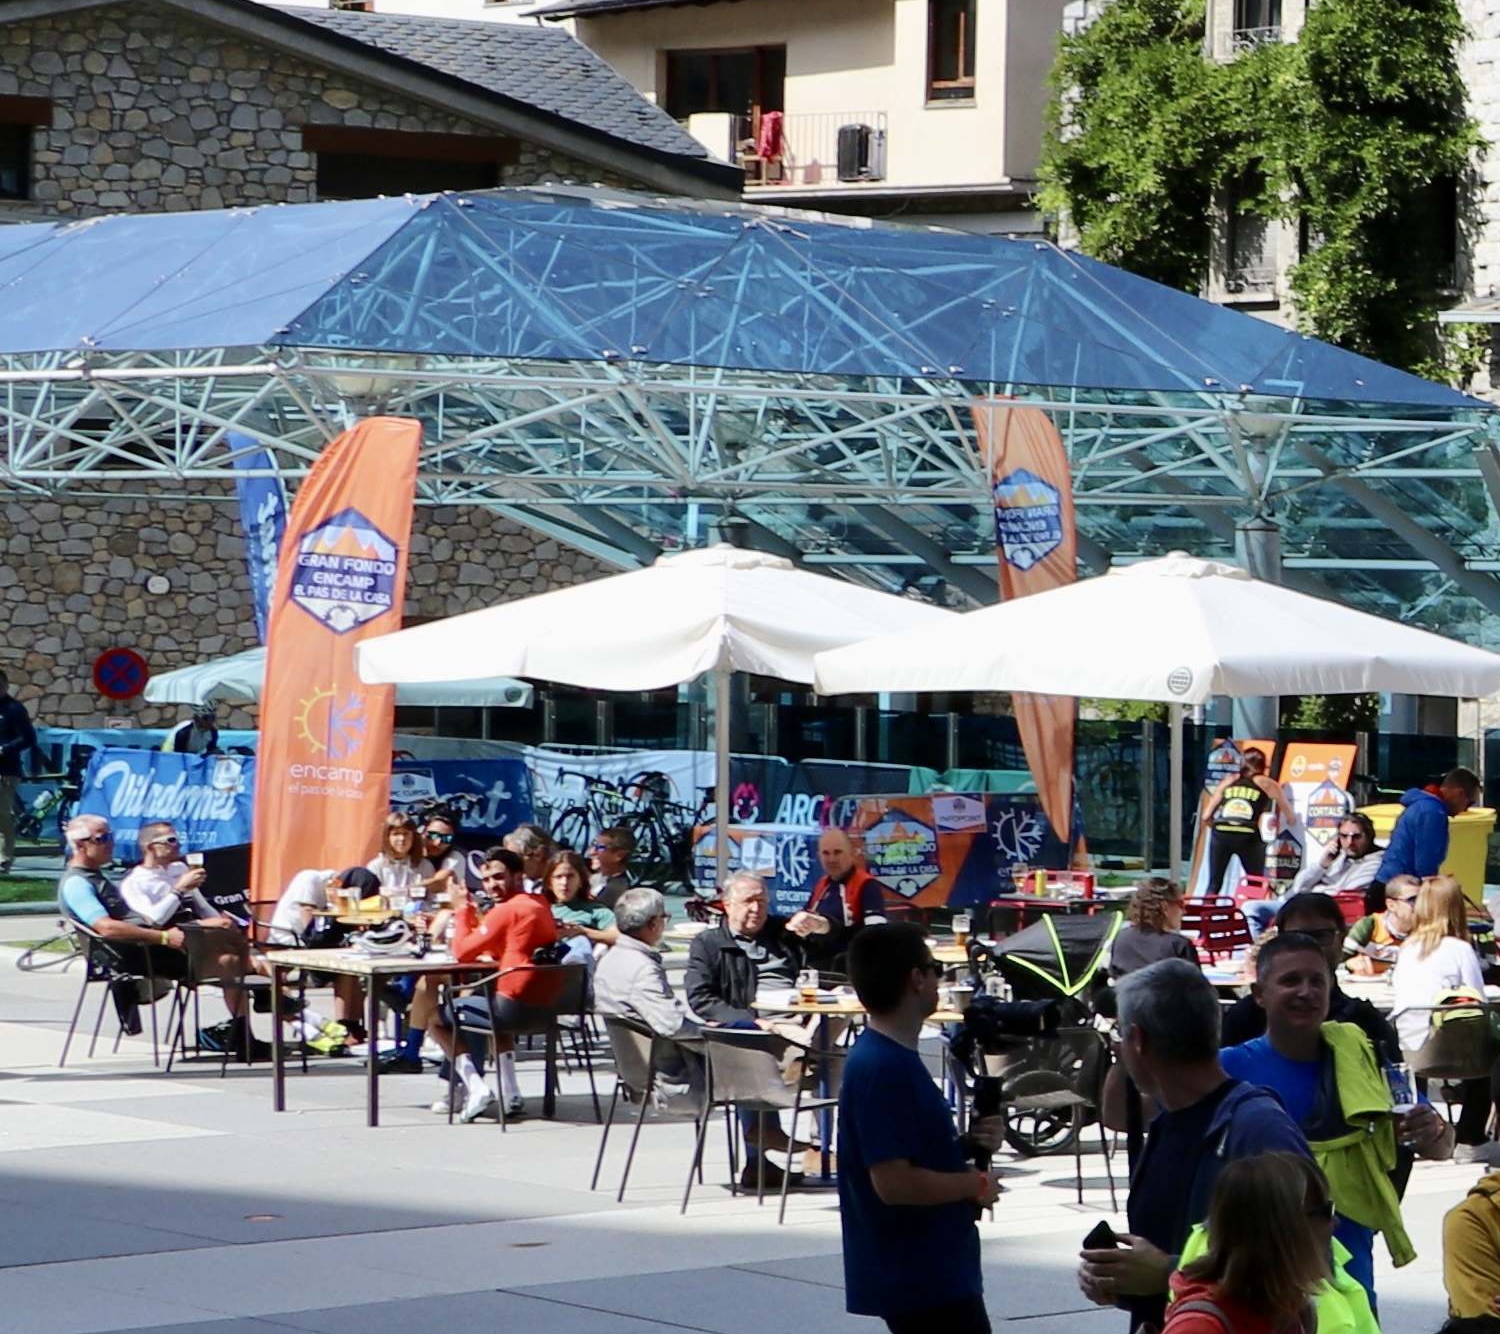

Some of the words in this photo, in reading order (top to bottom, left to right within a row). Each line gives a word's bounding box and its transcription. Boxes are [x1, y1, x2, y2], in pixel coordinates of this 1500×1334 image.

[298, 554, 340, 569] GRAN
[343, 558, 396, 576] FONDO
[313, 571, 375, 589] ENCAMP
[293, 584, 306, 596] EL
[307, 586, 329, 598] PAS
[331, 588, 348, 600] DE
[349, 590, 363, 602] LA
[363, 592, 392, 605] CASA
[289, 762, 364, 786] encamp
[1224, 785, 1262, 800] STAFF
[1308, 805, 1345, 818] CORTALS
[214, 891, 241, 907] Gran
